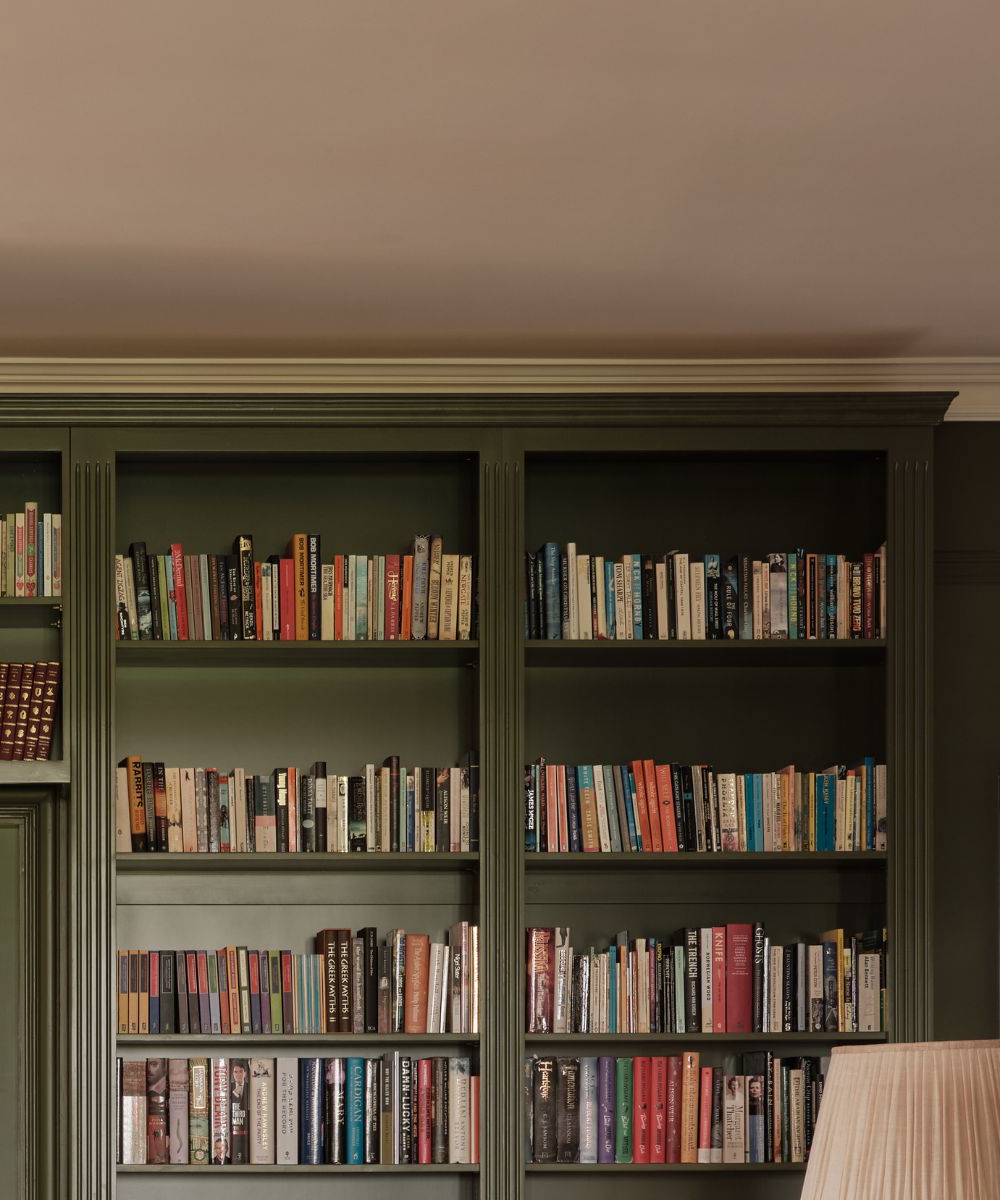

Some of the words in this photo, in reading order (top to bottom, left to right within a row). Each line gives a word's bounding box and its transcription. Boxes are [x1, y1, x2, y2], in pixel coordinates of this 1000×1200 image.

[310, 537, 318, 552] BOB
[310, 554, 318, 593] MORTIMER
[633, 561, 641, 581] NICK
[853, 576, 861, 597] BRAVO
[634, 592, 642, 627] HORNBY
[852, 599, 861, 614] TWO
[852, 615, 861, 632] ZERO
[132, 762, 143, 808] RABBITS
[328, 942, 336, 958] THE
[688, 930, 697, 946] THE
[715, 932, 724, 962] KNIFE
[754, 928, 764, 964] GHOSTS
[328, 959, 336, 984] GREEK
[689, 948, 698, 978] TRENCH
[402, 1060, 410, 1091] DAMN
[354, 1066, 362, 1122] CARDIGAN
[402, 1096, 410, 1131] LUCKY
[726, 1105, 736, 1141] Thatcher
